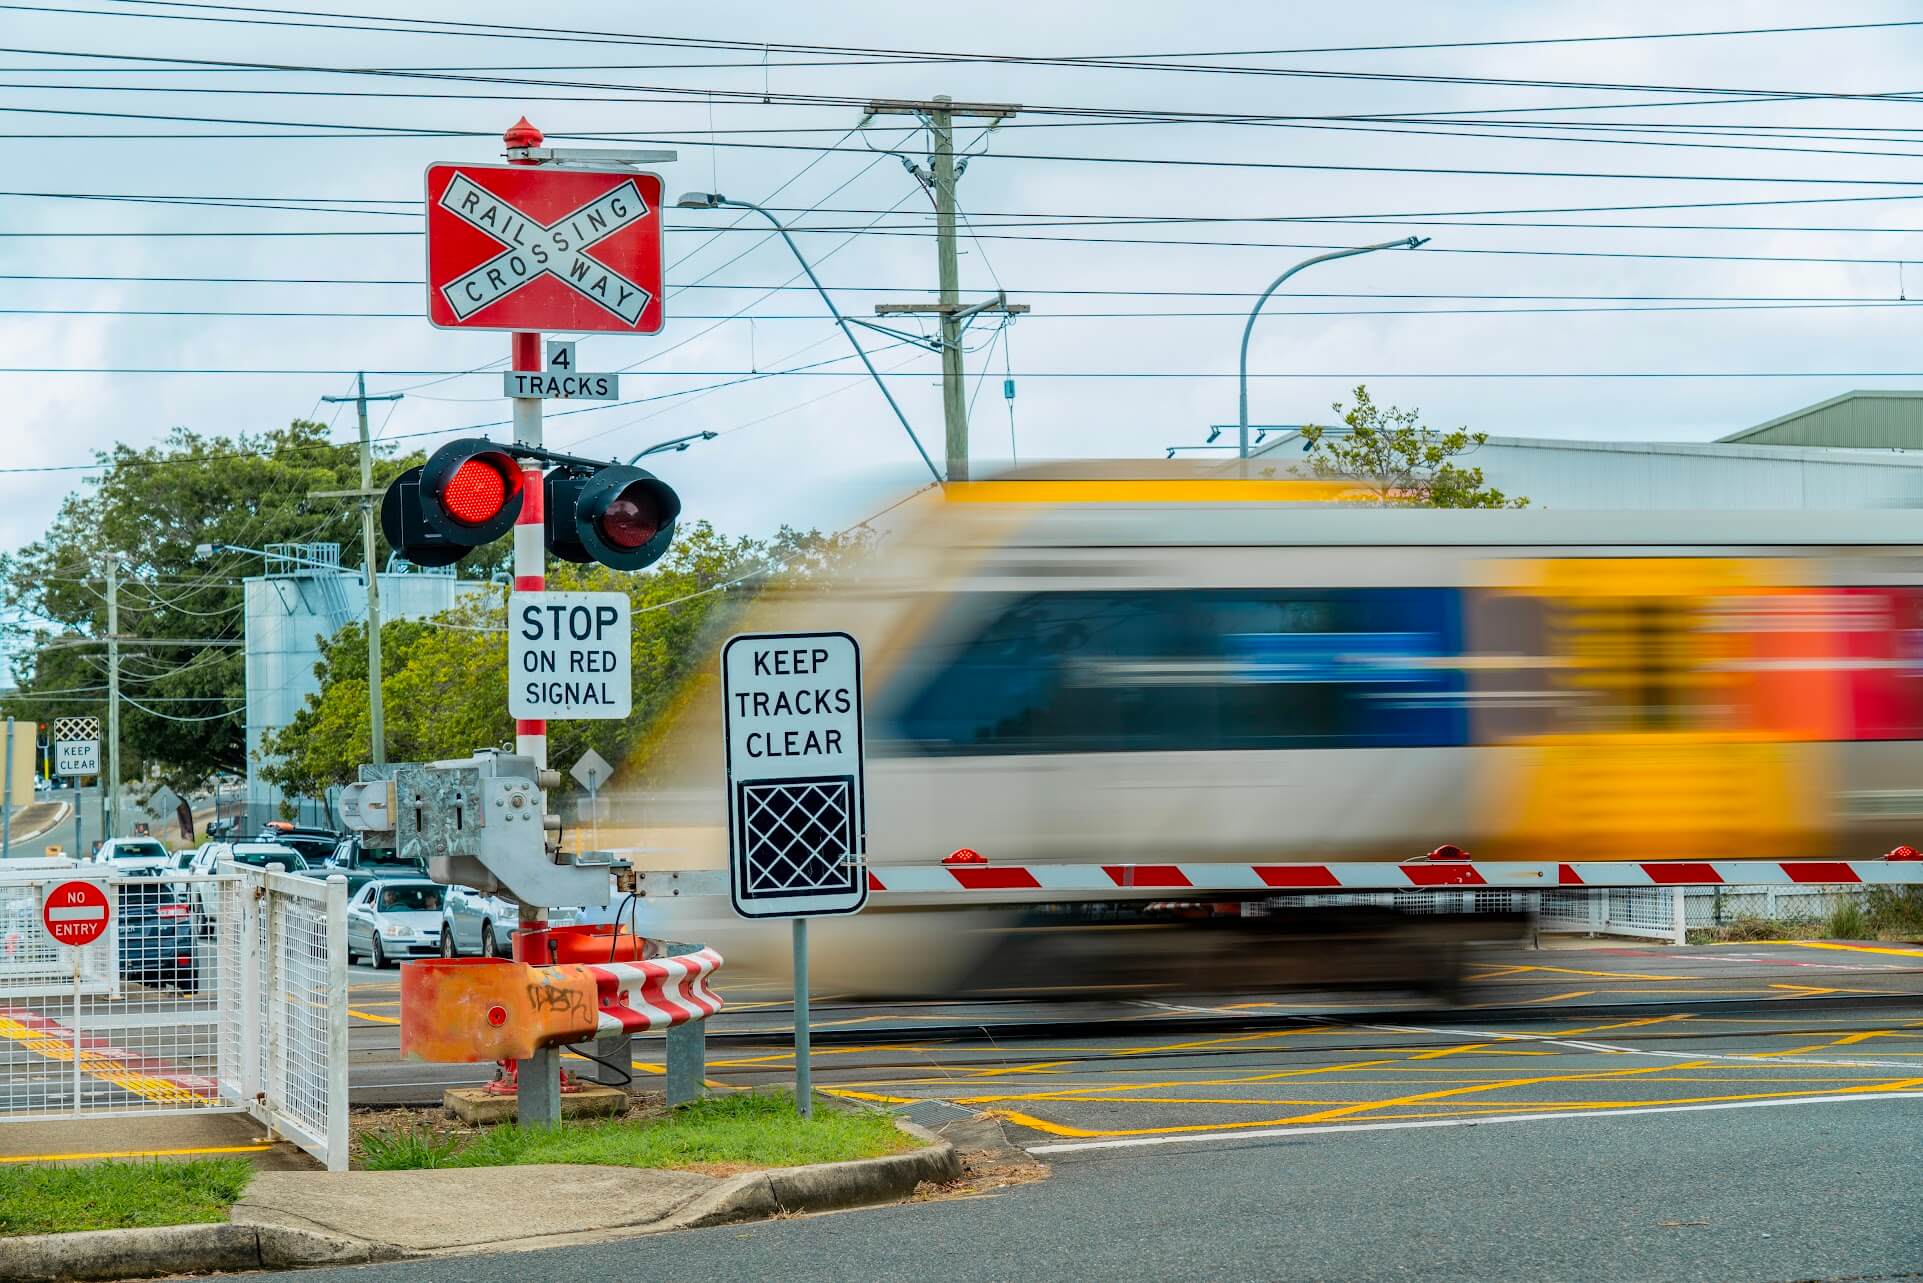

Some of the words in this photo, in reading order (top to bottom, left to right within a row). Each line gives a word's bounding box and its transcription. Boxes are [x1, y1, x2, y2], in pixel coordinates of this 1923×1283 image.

[551, 347, 570, 370] 4
[514, 375, 608, 396] TRACKS
[521, 605, 619, 641] STOP
[523, 650, 556, 673] ON
[570, 650, 617, 673] RED
[754, 648, 829, 676] KEEP
[526, 682, 616, 705] SIGNAL
[735, 688, 851, 718] TRACKS
[63, 746, 91, 756] KEEP
[746, 729, 843, 758] CLEAR
[60, 760, 95, 770] CLEAR
[67, 891, 86, 904] NO
[55, 922, 98, 937] ENTRY
